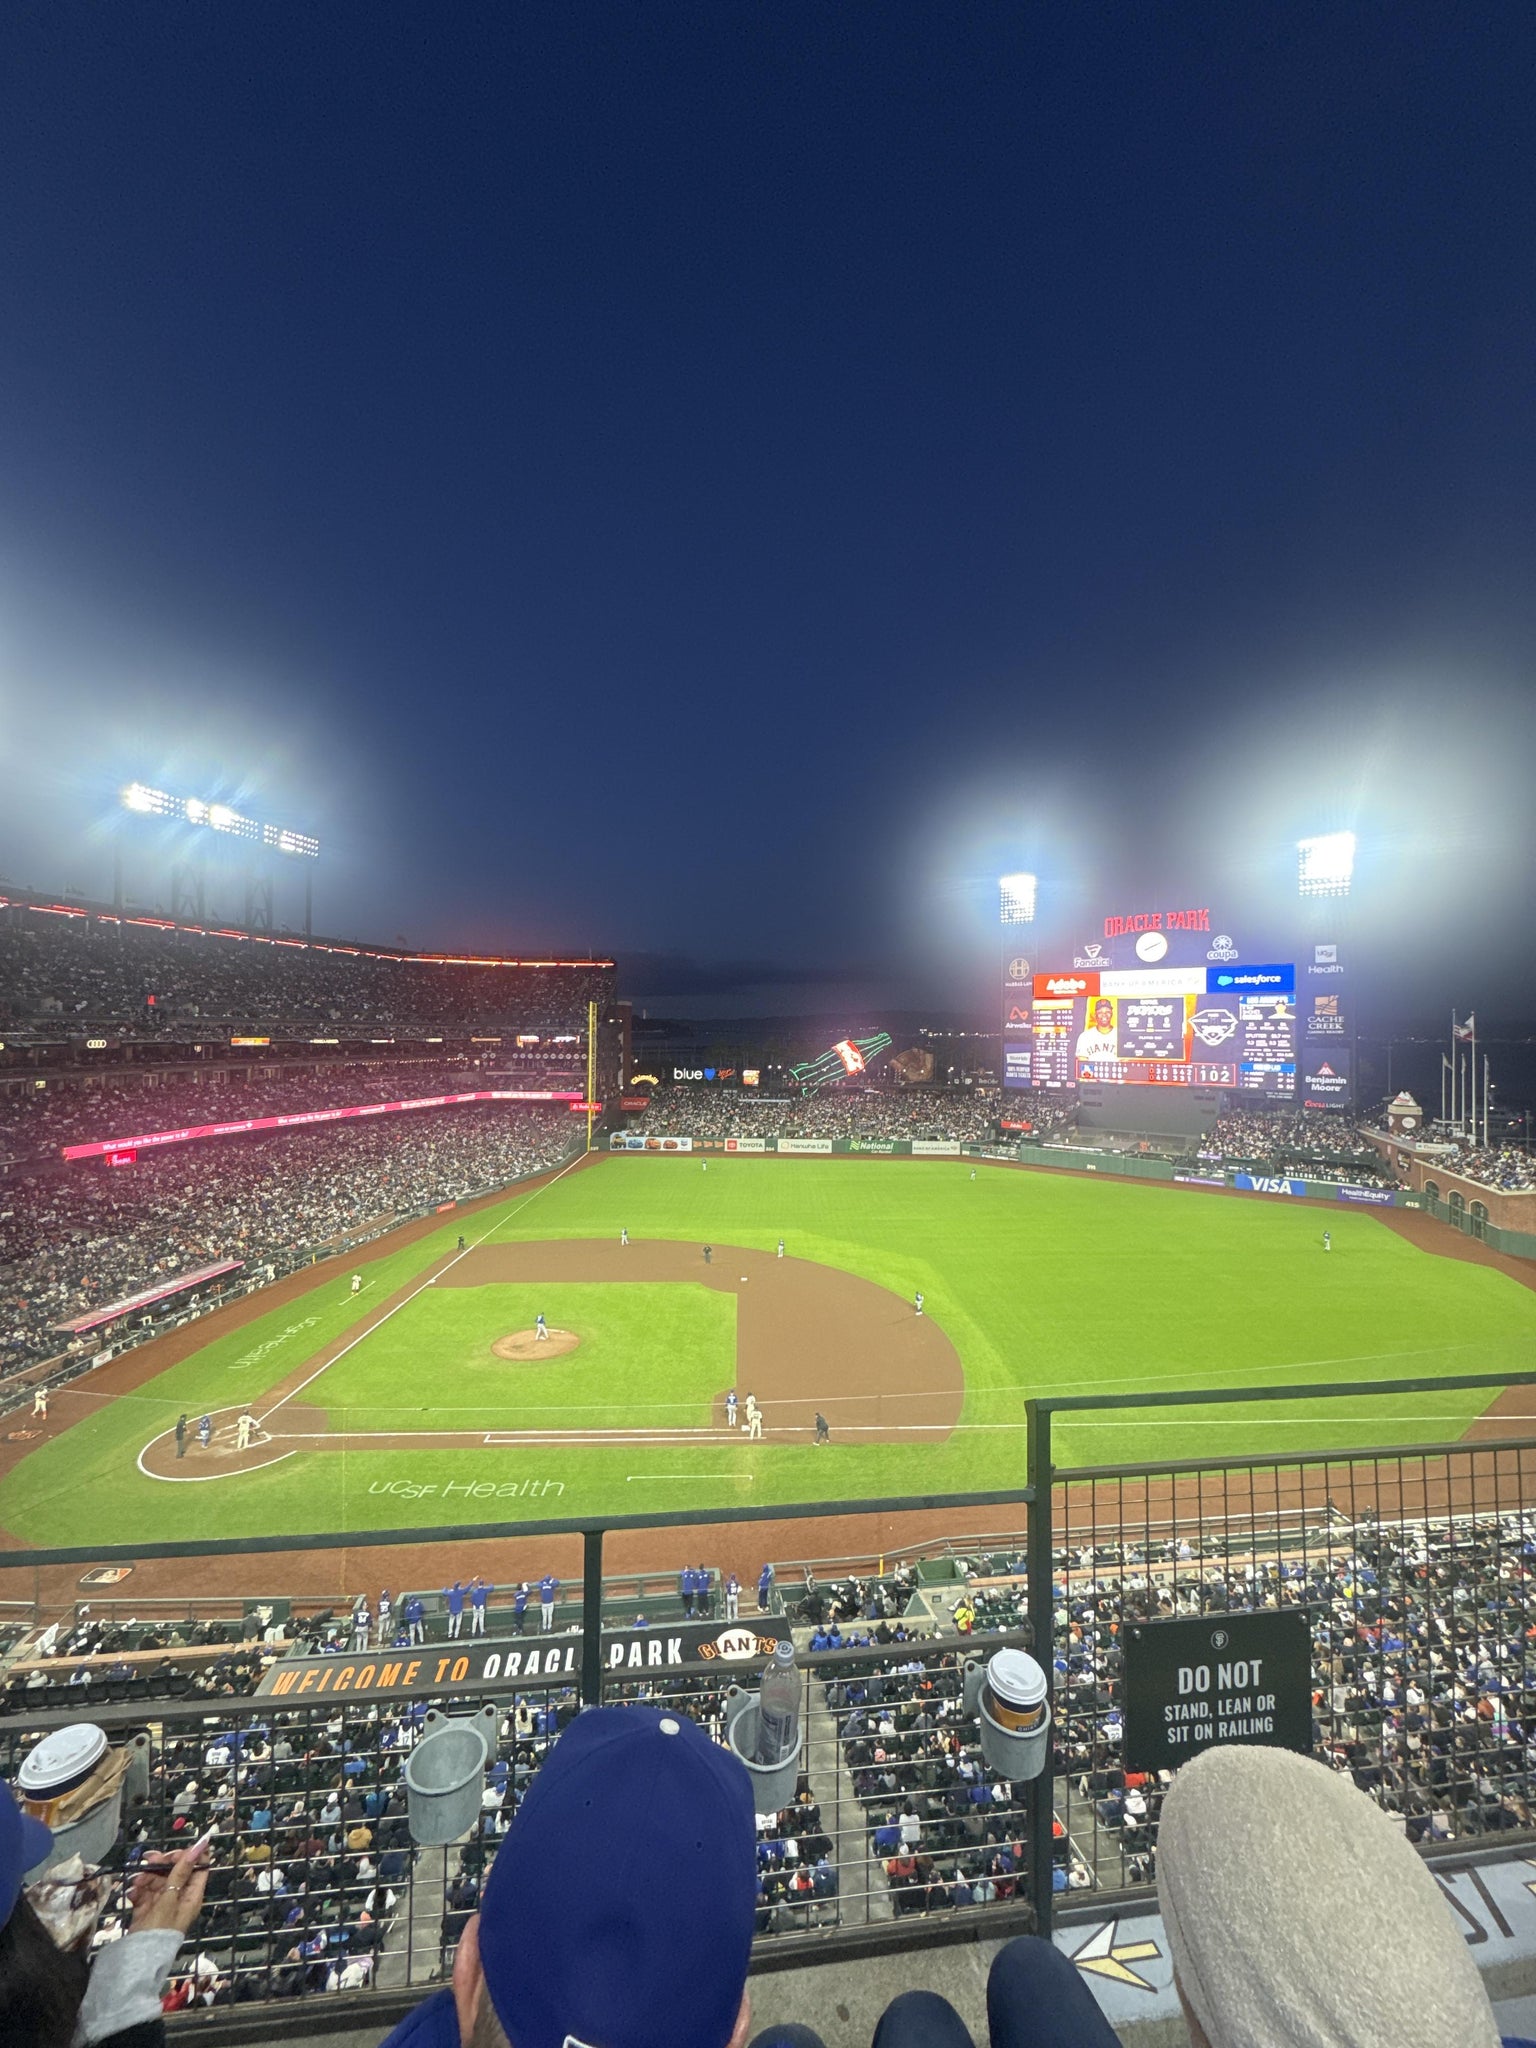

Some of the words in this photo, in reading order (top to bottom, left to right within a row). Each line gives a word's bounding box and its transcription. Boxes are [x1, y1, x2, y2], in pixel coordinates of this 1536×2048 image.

[1104, 913, 1162, 938] ORACLE
[1166, 909, 1210, 931] PARK
[1207, 948, 1238, 961] coupa
[1308, 965, 1344, 974] Health
[1046, 978, 1086, 991] Adobe
[1234, 974, 1281, 985] salesforce
[1087, 1043, 1116, 1056] GIANT
[674, 1067, 703, 1080] blue
[1210, 1070, 1218, 1082] 0
[1221, 1071, 1229, 1082] 2
[1305, 1076, 1347, 1084] Benjamin
[791, 1141, 816, 1149] Hanwha
[817, 1141, 829, 1149] Life
[860, 1142, 894, 1151] National
[1248, 1176, 1292, 1195] VISA
[1341, 1188, 1390, 1201] HealthEquity
[227, 1334, 297, 1369] Health
[368, 1480, 438, 1499] UCSF
[441, 1479, 565, 1498] Health
[698, 1635, 778, 1661] GIANTS
[434, 1657, 469, 1683] TO
[483, 1647, 575, 1680] ORACL
[609, 1637, 683, 1669] PARK
[1178, 1665, 1211, 1695] DO
[1218, 1659, 1263, 1690] NOT
[1164, 1701, 1213, 1722] STAND,
[1218, 1697, 1251, 1716] LEAN
[1257, 1694, 1276, 1712] OR
[1167, 1725, 1190, 1744] SIT
[1194, 1723, 1213, 1740] ON
[1219, 1716, 1273, 1739] RAILING
[403, 1735, 410, 1745] 17
